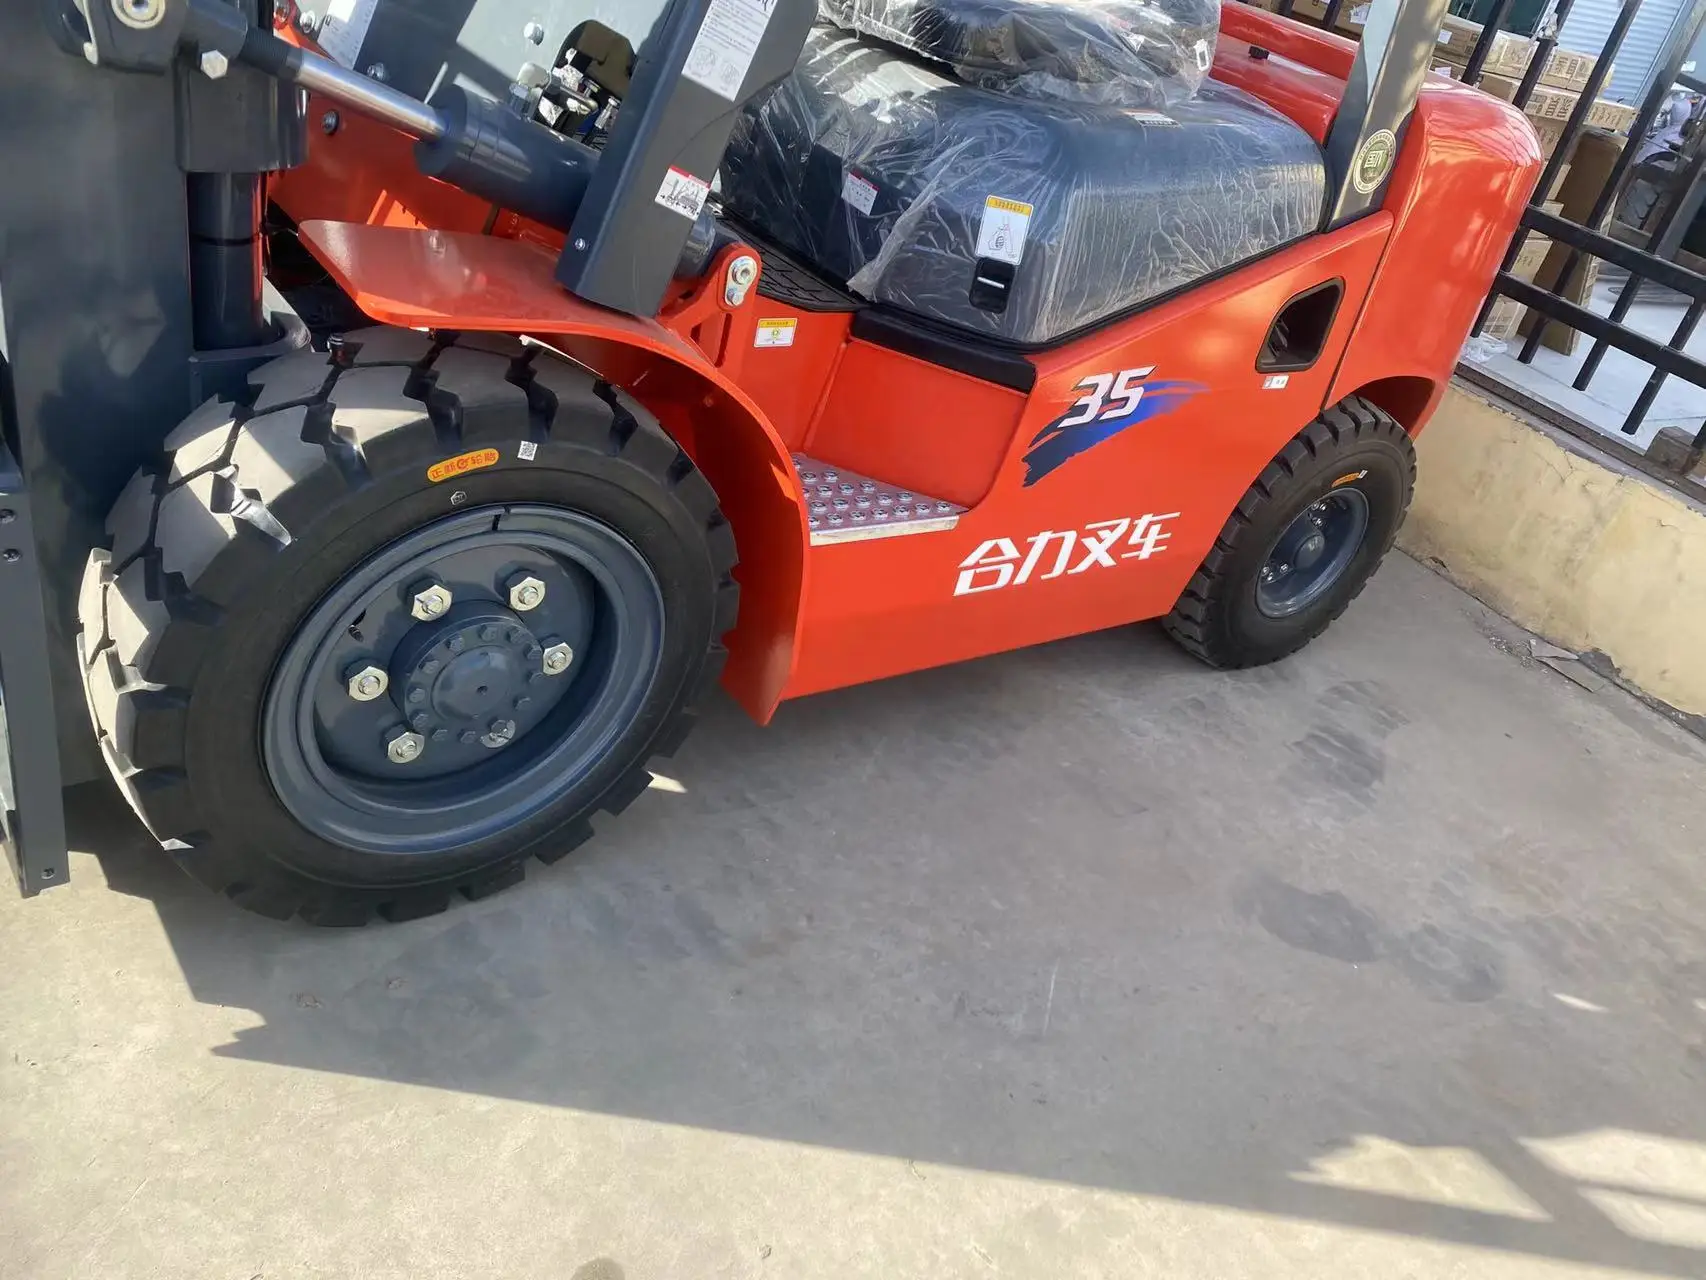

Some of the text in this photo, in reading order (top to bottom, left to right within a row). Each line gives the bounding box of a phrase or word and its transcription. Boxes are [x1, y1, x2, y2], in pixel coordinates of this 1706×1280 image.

[1057, 365, 1157, 428] 35
[953, 511, 1182, 597] 合力叉车
